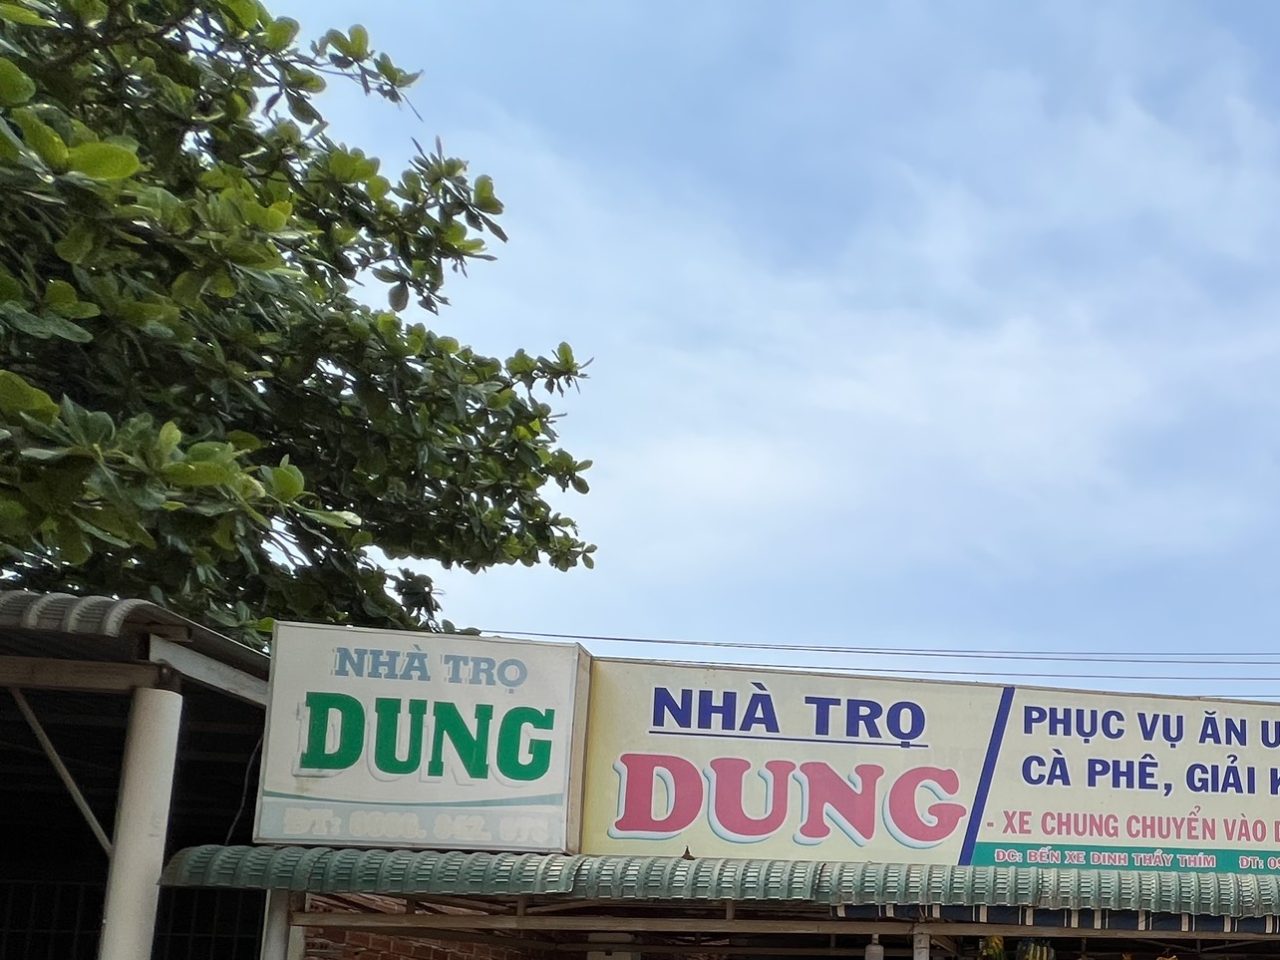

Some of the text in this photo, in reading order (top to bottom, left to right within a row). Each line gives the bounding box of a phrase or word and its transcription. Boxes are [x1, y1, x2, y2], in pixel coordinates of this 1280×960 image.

[333, 644, 528, 694] NHÀ TRỌ
[299, 691, 556, 781] DUNG
[652, 681, 926, 749] NHÀ TRỌ
[1023, 705, 1126, 744] PHỤC
[1136, 712, 1184, 749] VỤ
[1198, 710, 1247, 747] ĂN
[1021, 748, 1072, 786] CÀ
[1087, 753, 1173, 797] PHÊ,
[1185, 754, 1256, 795] GIẢI
[612, 752, 967, 844] DUNG
[1002, 810, 1032, 834] XE
[1040, 811, 1119, 838] CHUNG
[1126, 805, 1216, 841] CHUYỂN
[1223, 813, 1267, 843] VÀO
[1027, 846, 1061, 864] BẾN
[1065, 850, 1085, 865] XE
[1090, 851, 1128, 866] DINH
[1178, 851, 1217, 868] THÍM
